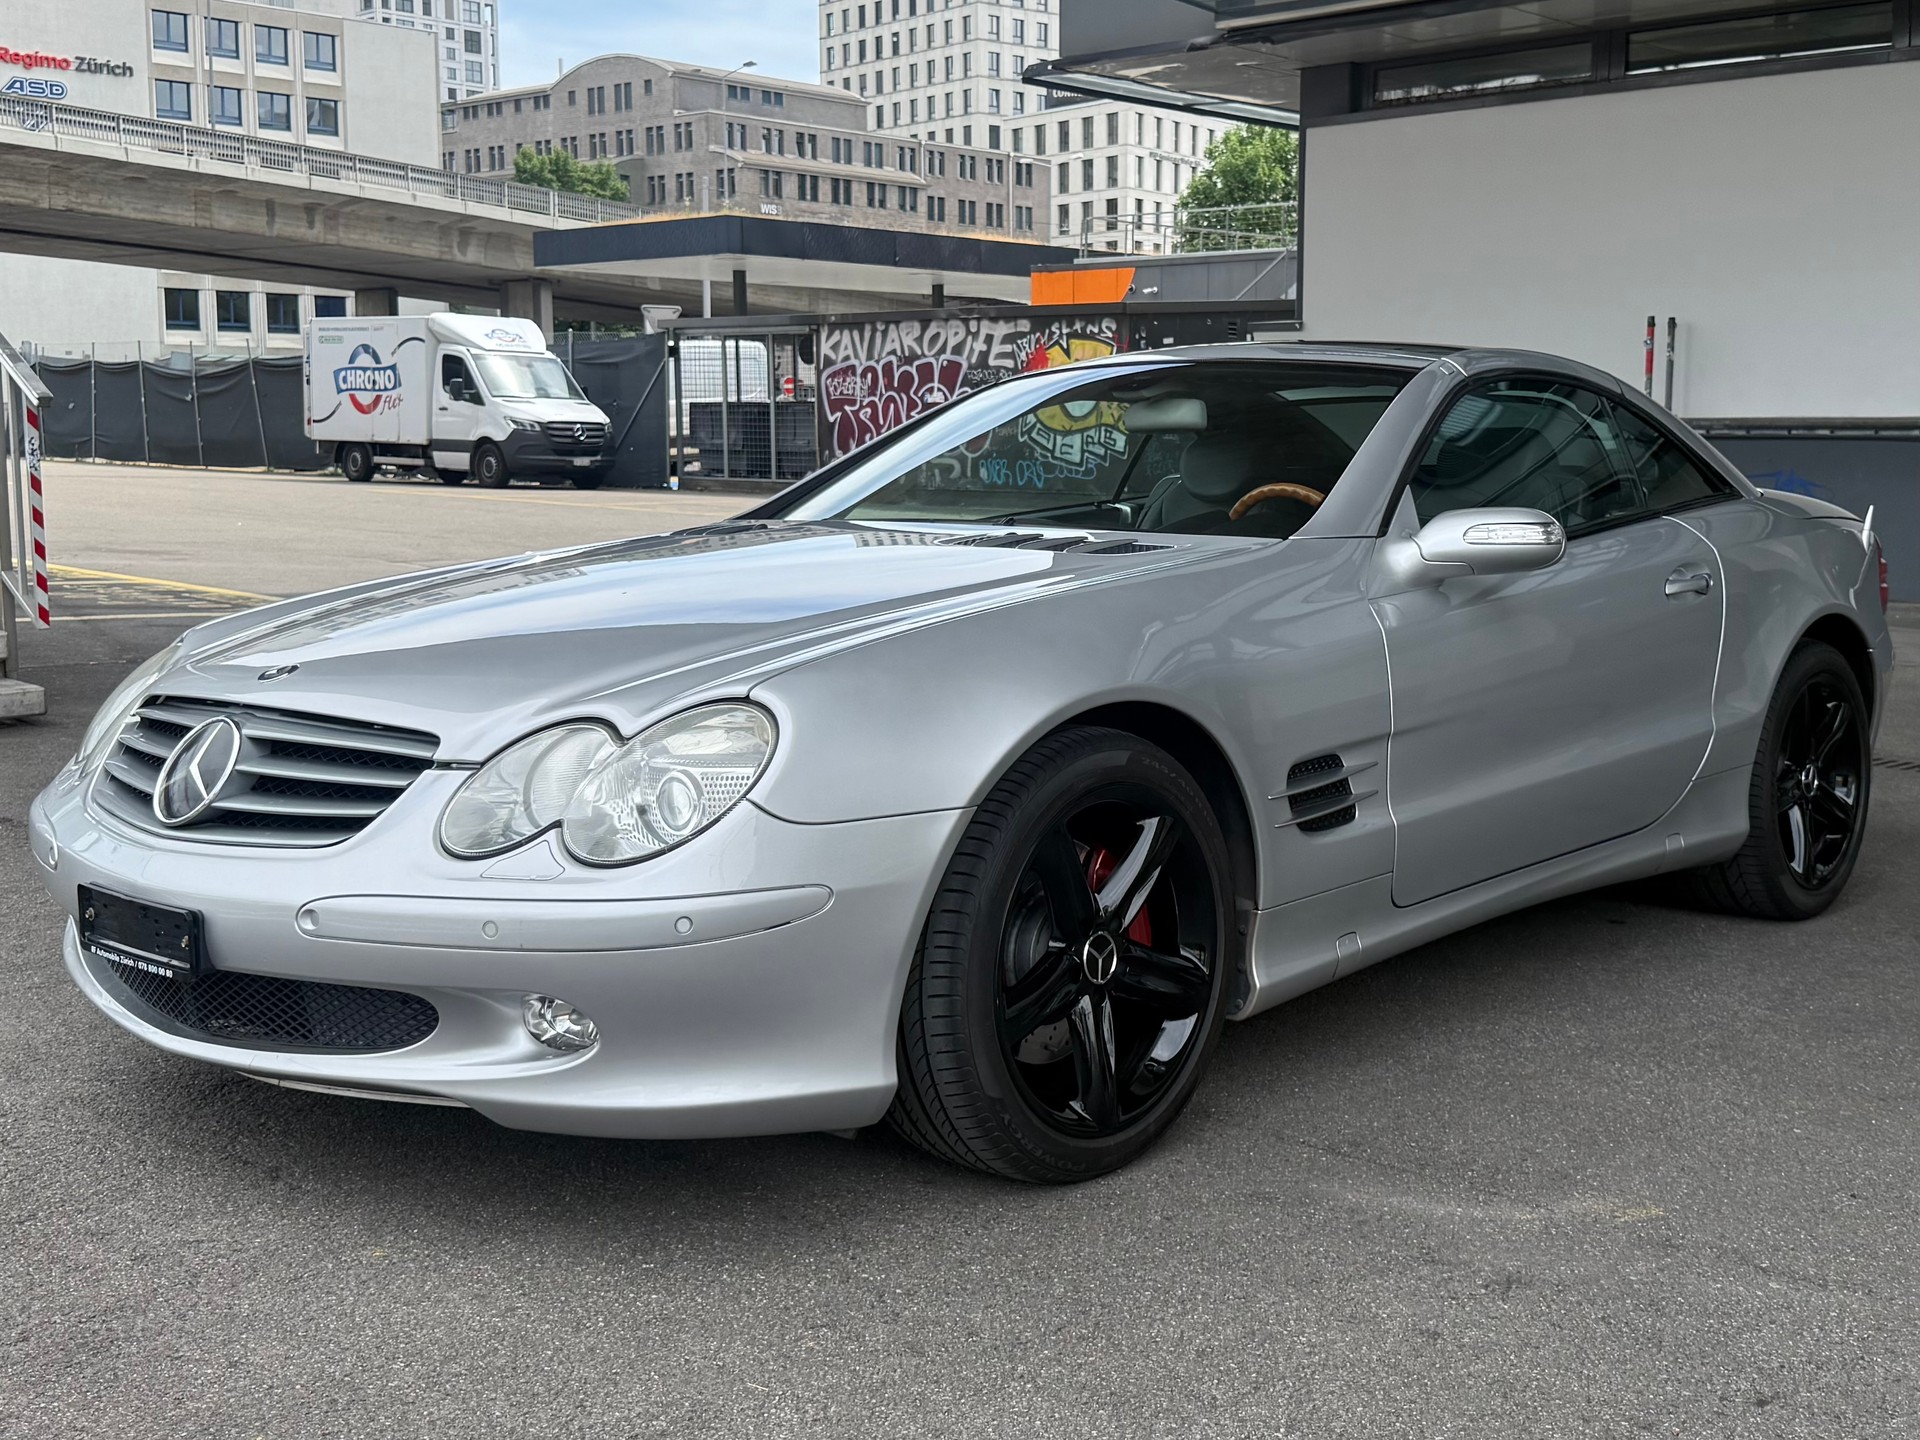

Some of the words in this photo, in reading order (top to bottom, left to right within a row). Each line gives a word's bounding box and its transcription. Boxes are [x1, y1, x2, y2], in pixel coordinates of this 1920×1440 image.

[0, 47, 71, 70] Regimo
[75, 56, 134, 77] Zürich
[1, 76, 68, 99] ASD
[338, 369, 395, 390] CHRONO
